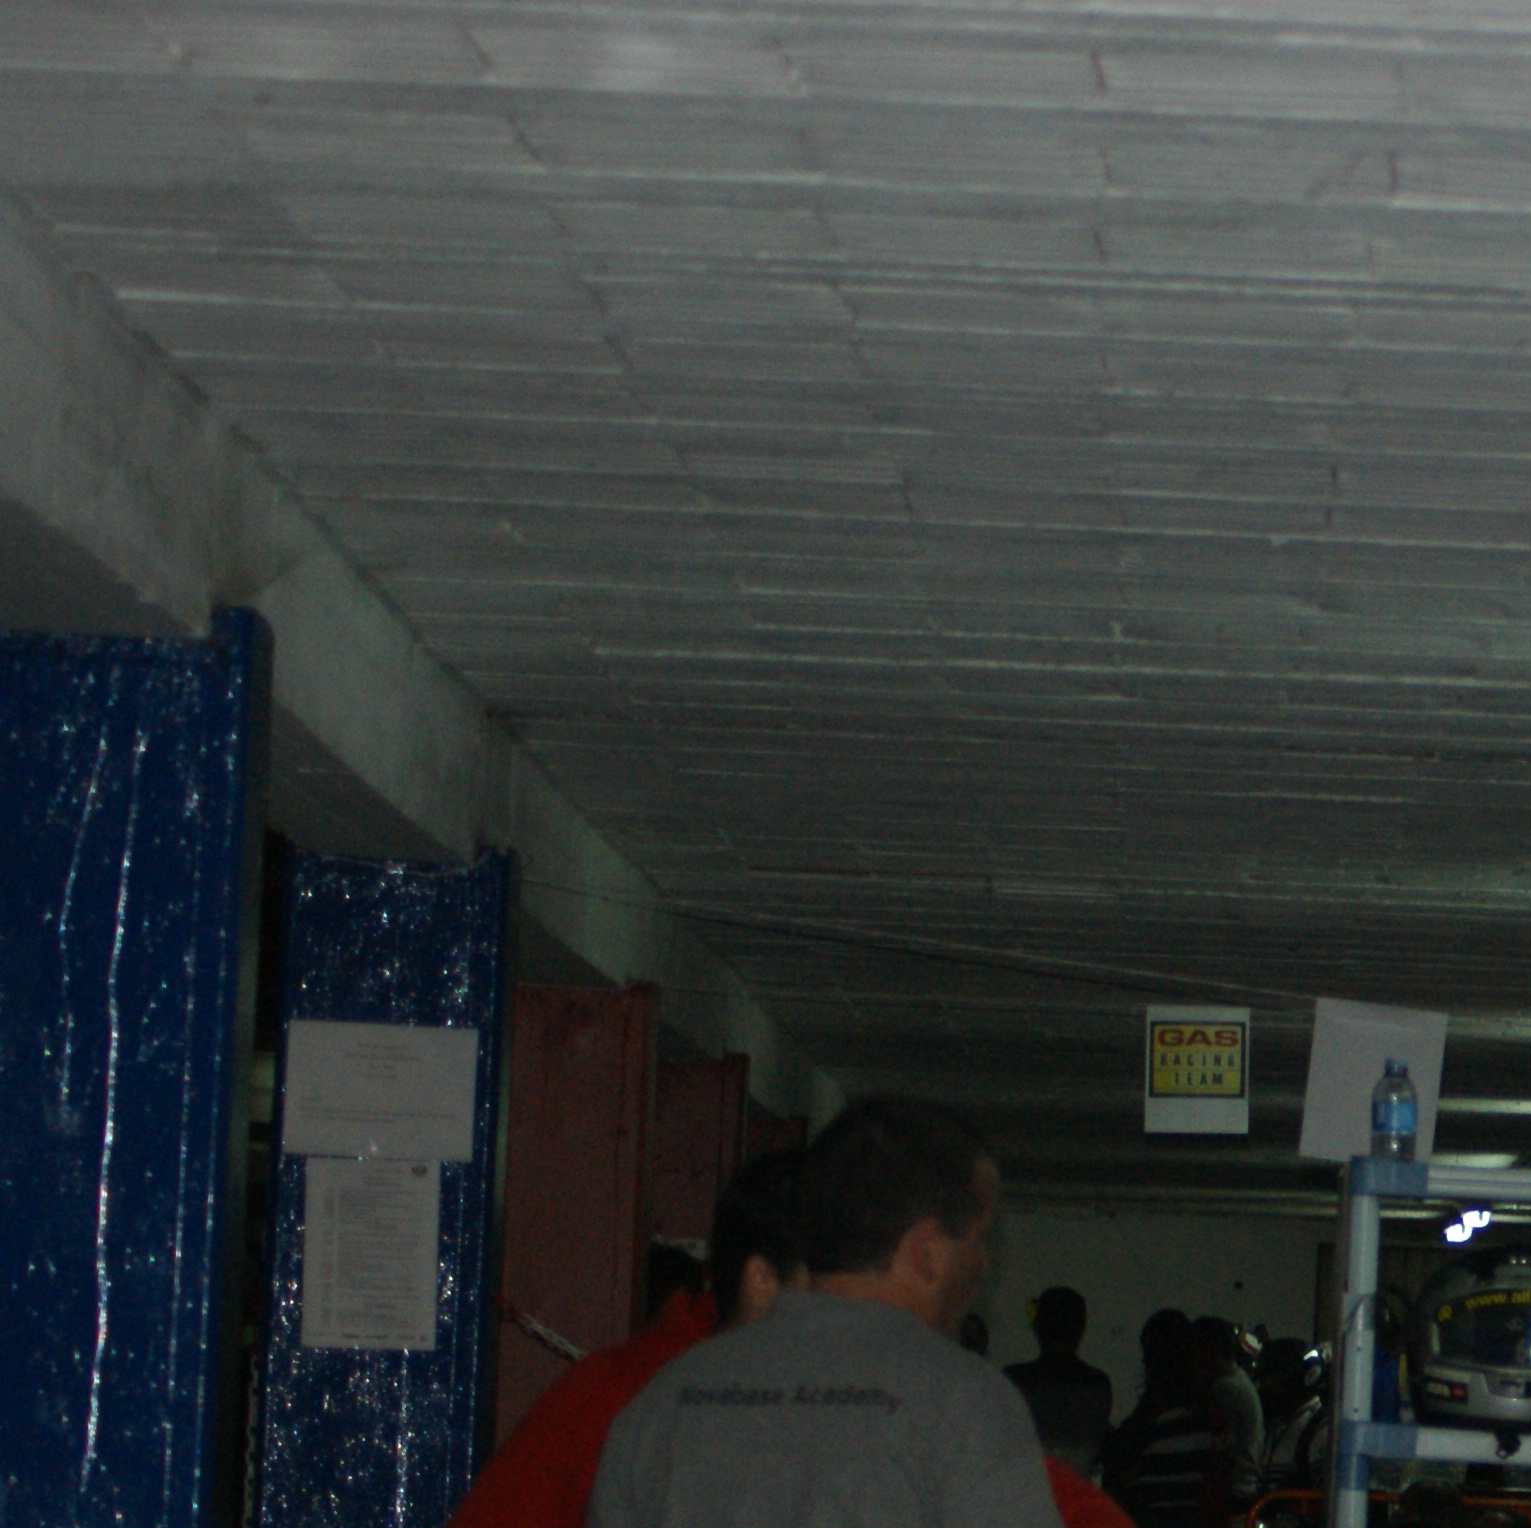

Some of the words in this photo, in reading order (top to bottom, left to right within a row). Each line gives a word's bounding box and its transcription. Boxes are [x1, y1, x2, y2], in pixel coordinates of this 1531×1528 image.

[1157, 1028, 1239, 1047] GAS
[1159, 1052, 1236, 1068] RACING
[1174, 1071, 1224, 1086] TEAM
